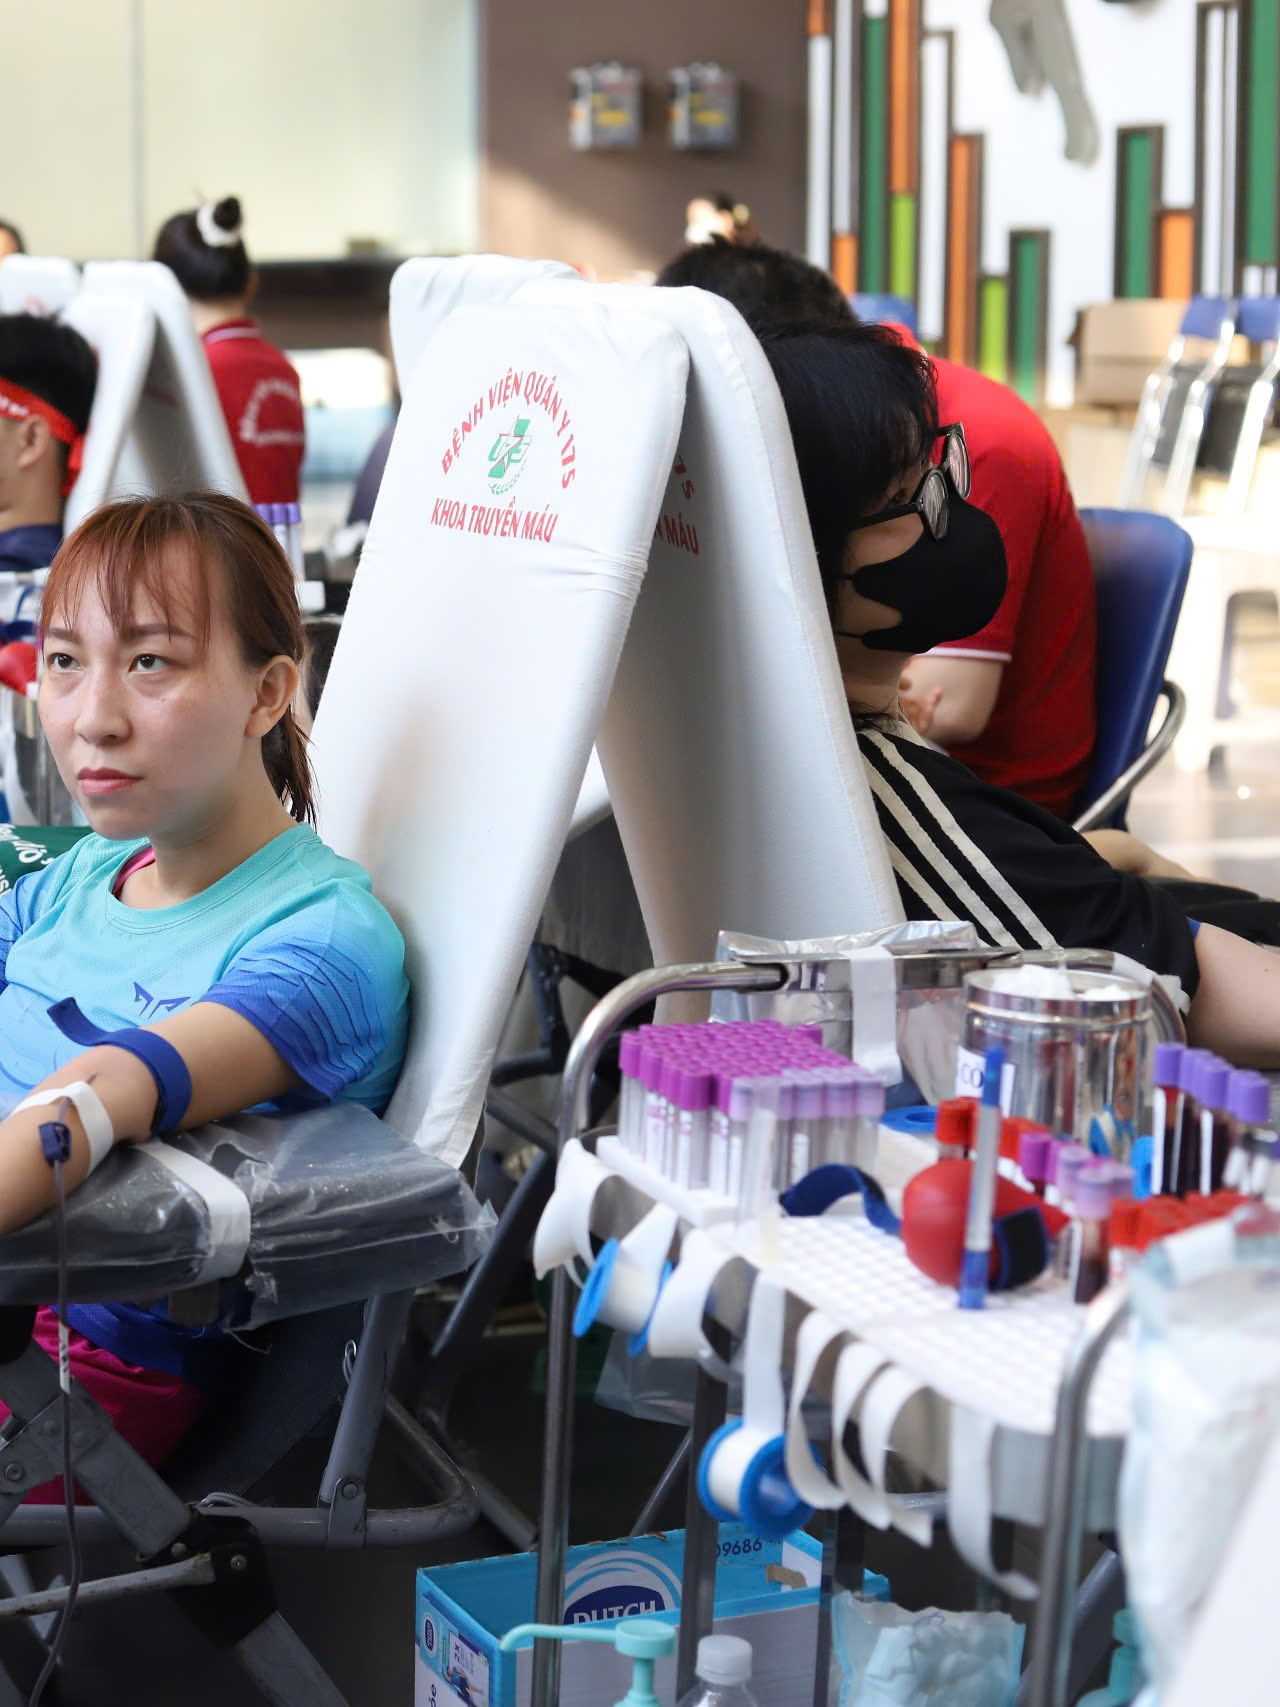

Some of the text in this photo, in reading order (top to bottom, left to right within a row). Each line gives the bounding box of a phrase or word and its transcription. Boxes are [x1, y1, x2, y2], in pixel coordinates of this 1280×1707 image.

[441, 367, 576, 489] BỆNH VIỆN QUÂN Y 175
[430, 497, 468, 531] KHOA
[521, 503, 559, 543] MÁU
